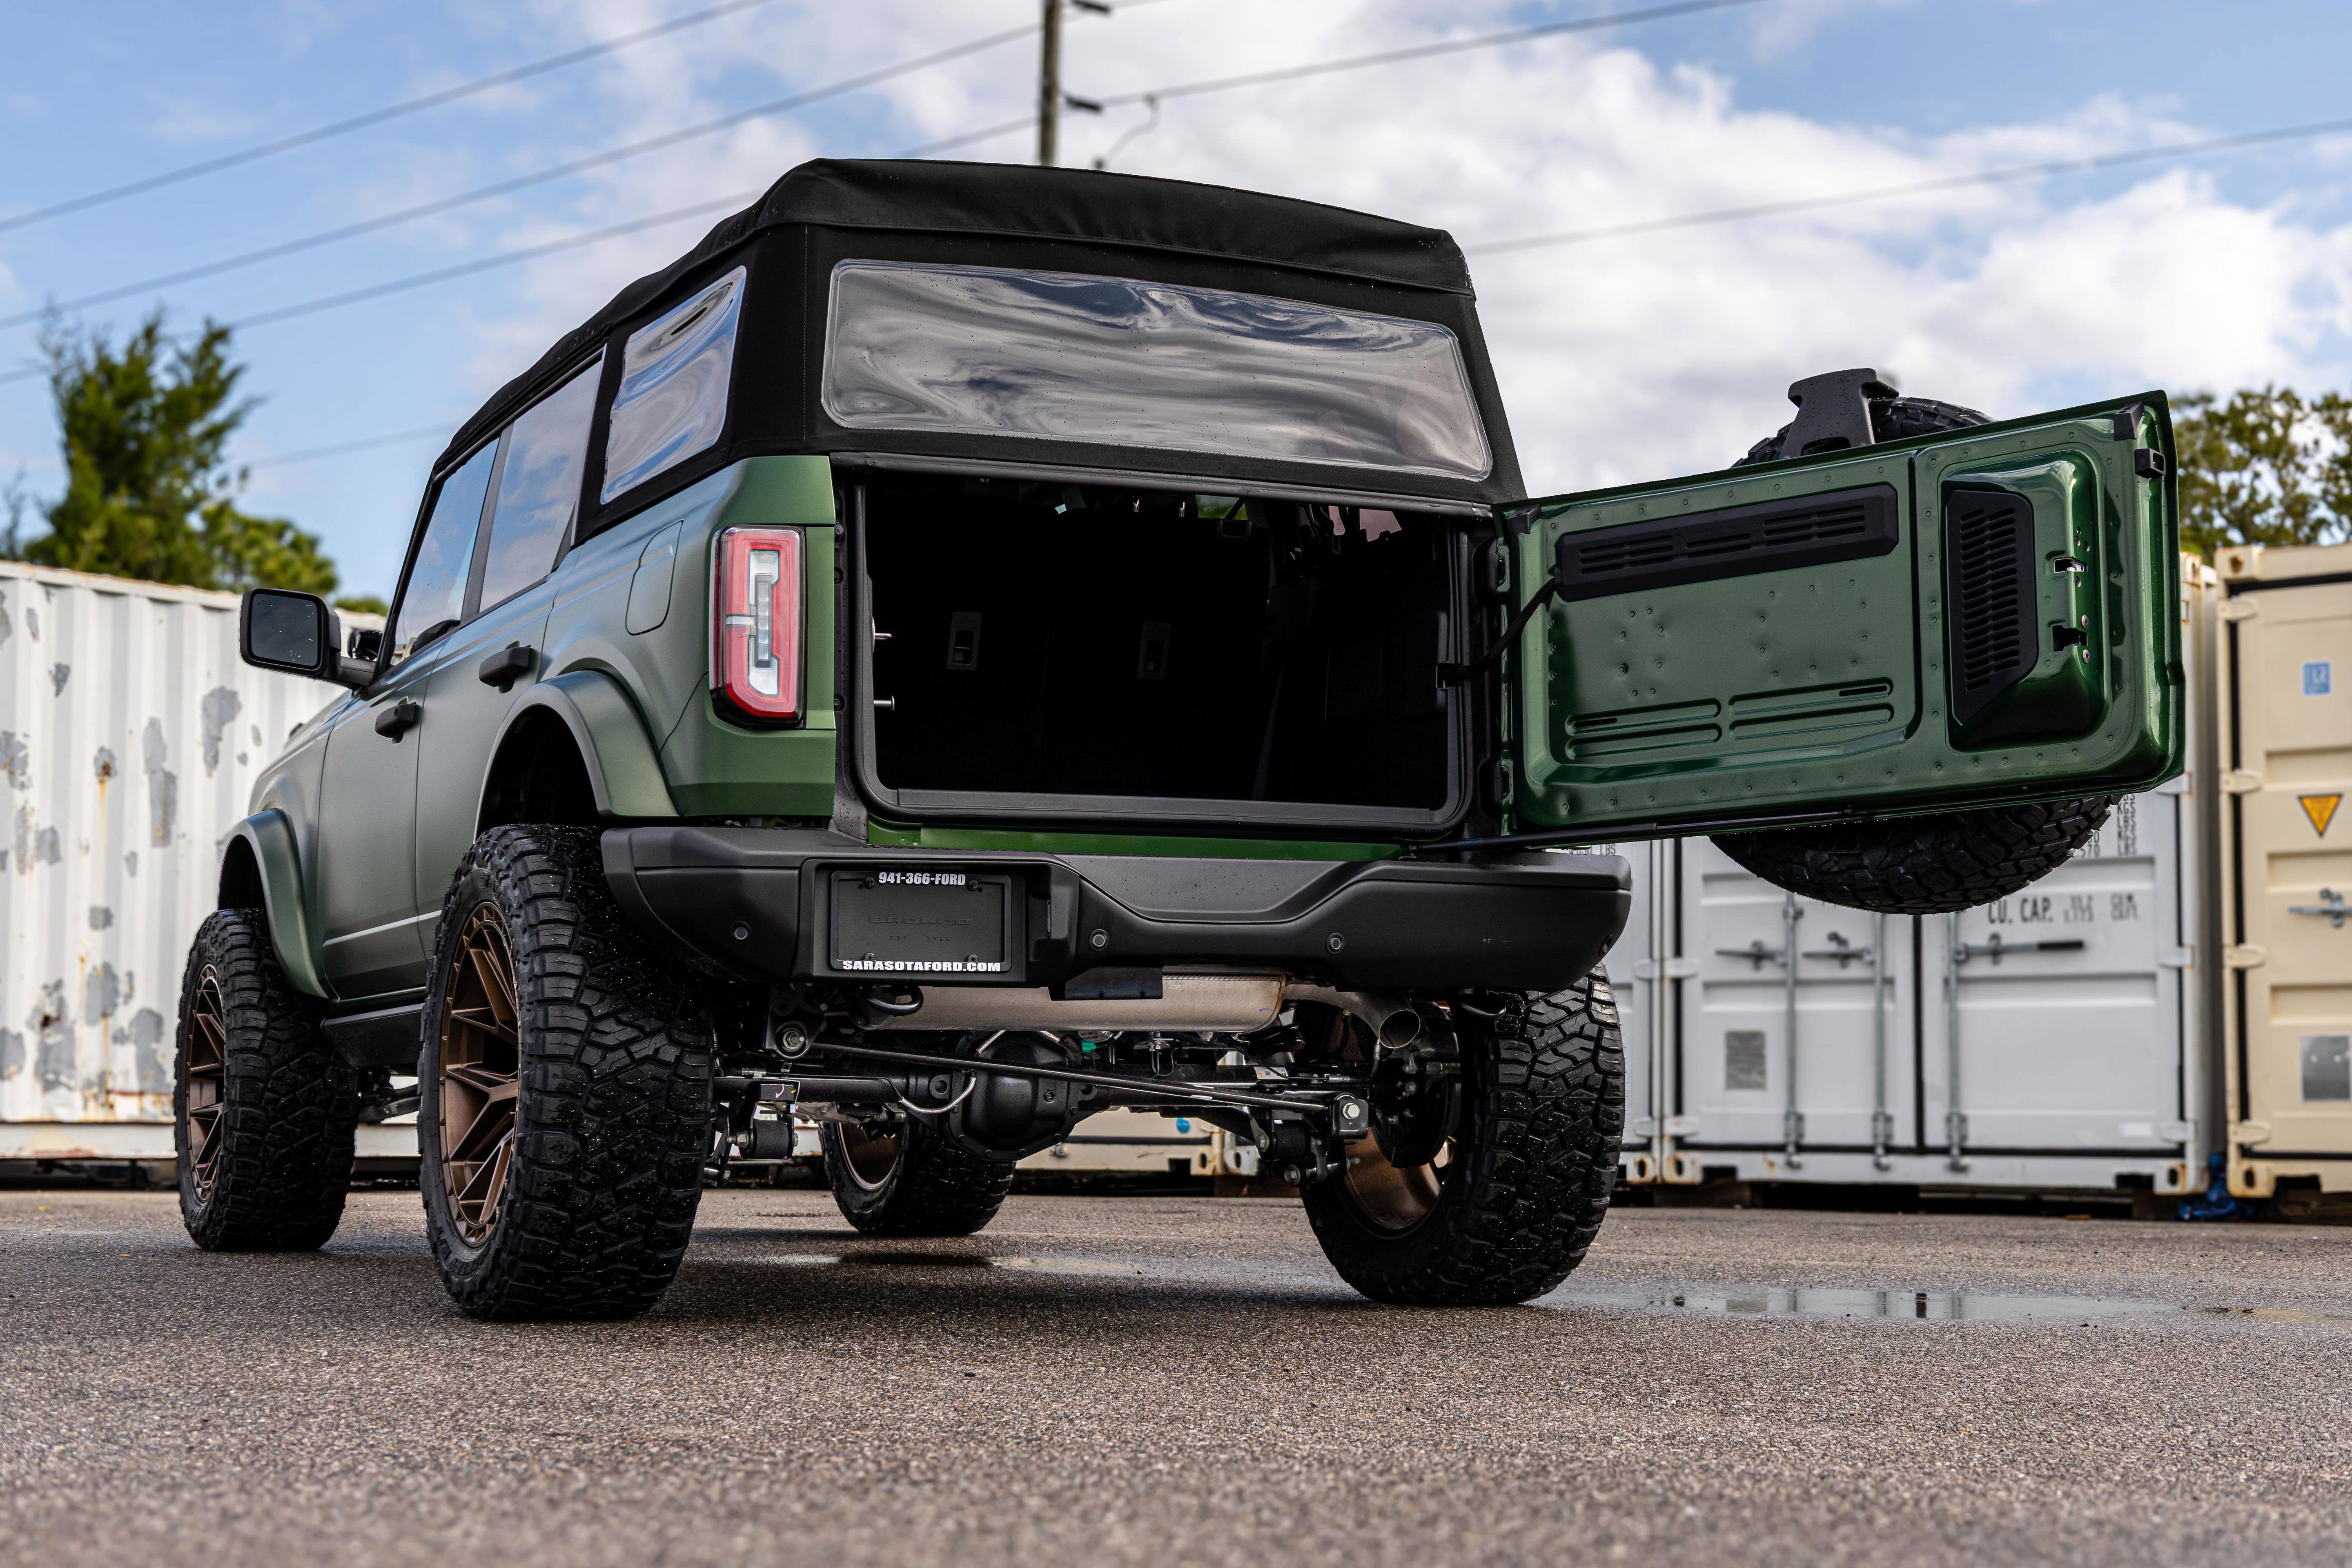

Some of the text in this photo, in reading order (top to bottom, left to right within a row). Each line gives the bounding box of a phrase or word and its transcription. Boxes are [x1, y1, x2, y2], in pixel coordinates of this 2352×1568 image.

[2117, 802, 2136, 814] KGS
[878, 872, 966, 886] 941-366-FORD
[869, 917, 971, 925] BRONCO
[842, 960, 1001, 972] SARASOTAFORD.COM
